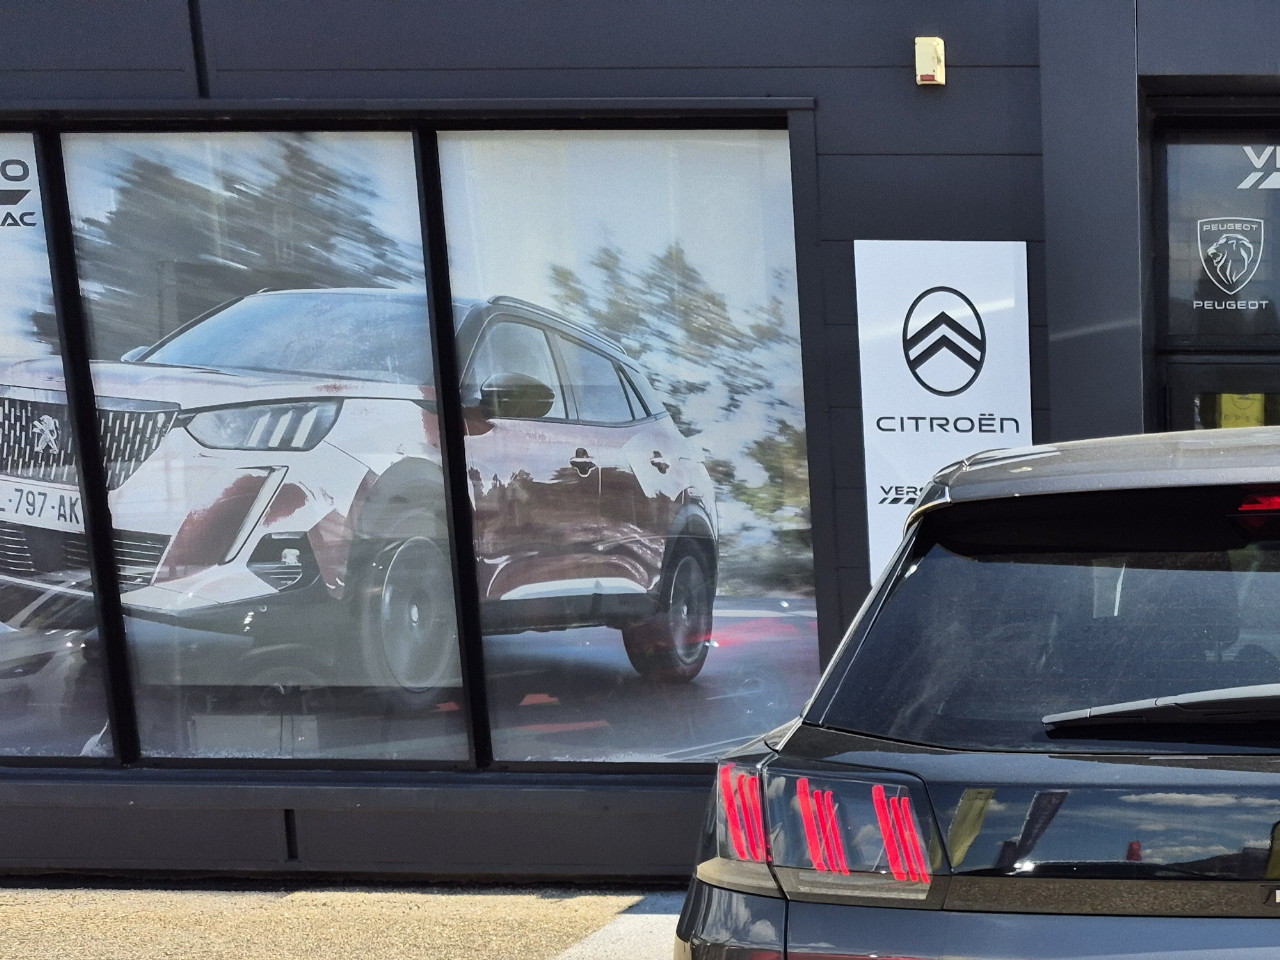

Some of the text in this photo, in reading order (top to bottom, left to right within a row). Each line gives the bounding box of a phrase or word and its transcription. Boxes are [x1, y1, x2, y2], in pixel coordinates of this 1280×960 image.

[1202, 222, 1259, 232] PEUGEOT
[1193, 300, 1269, 310] PEUGEOT
[880, 486, 924, 496] VER
